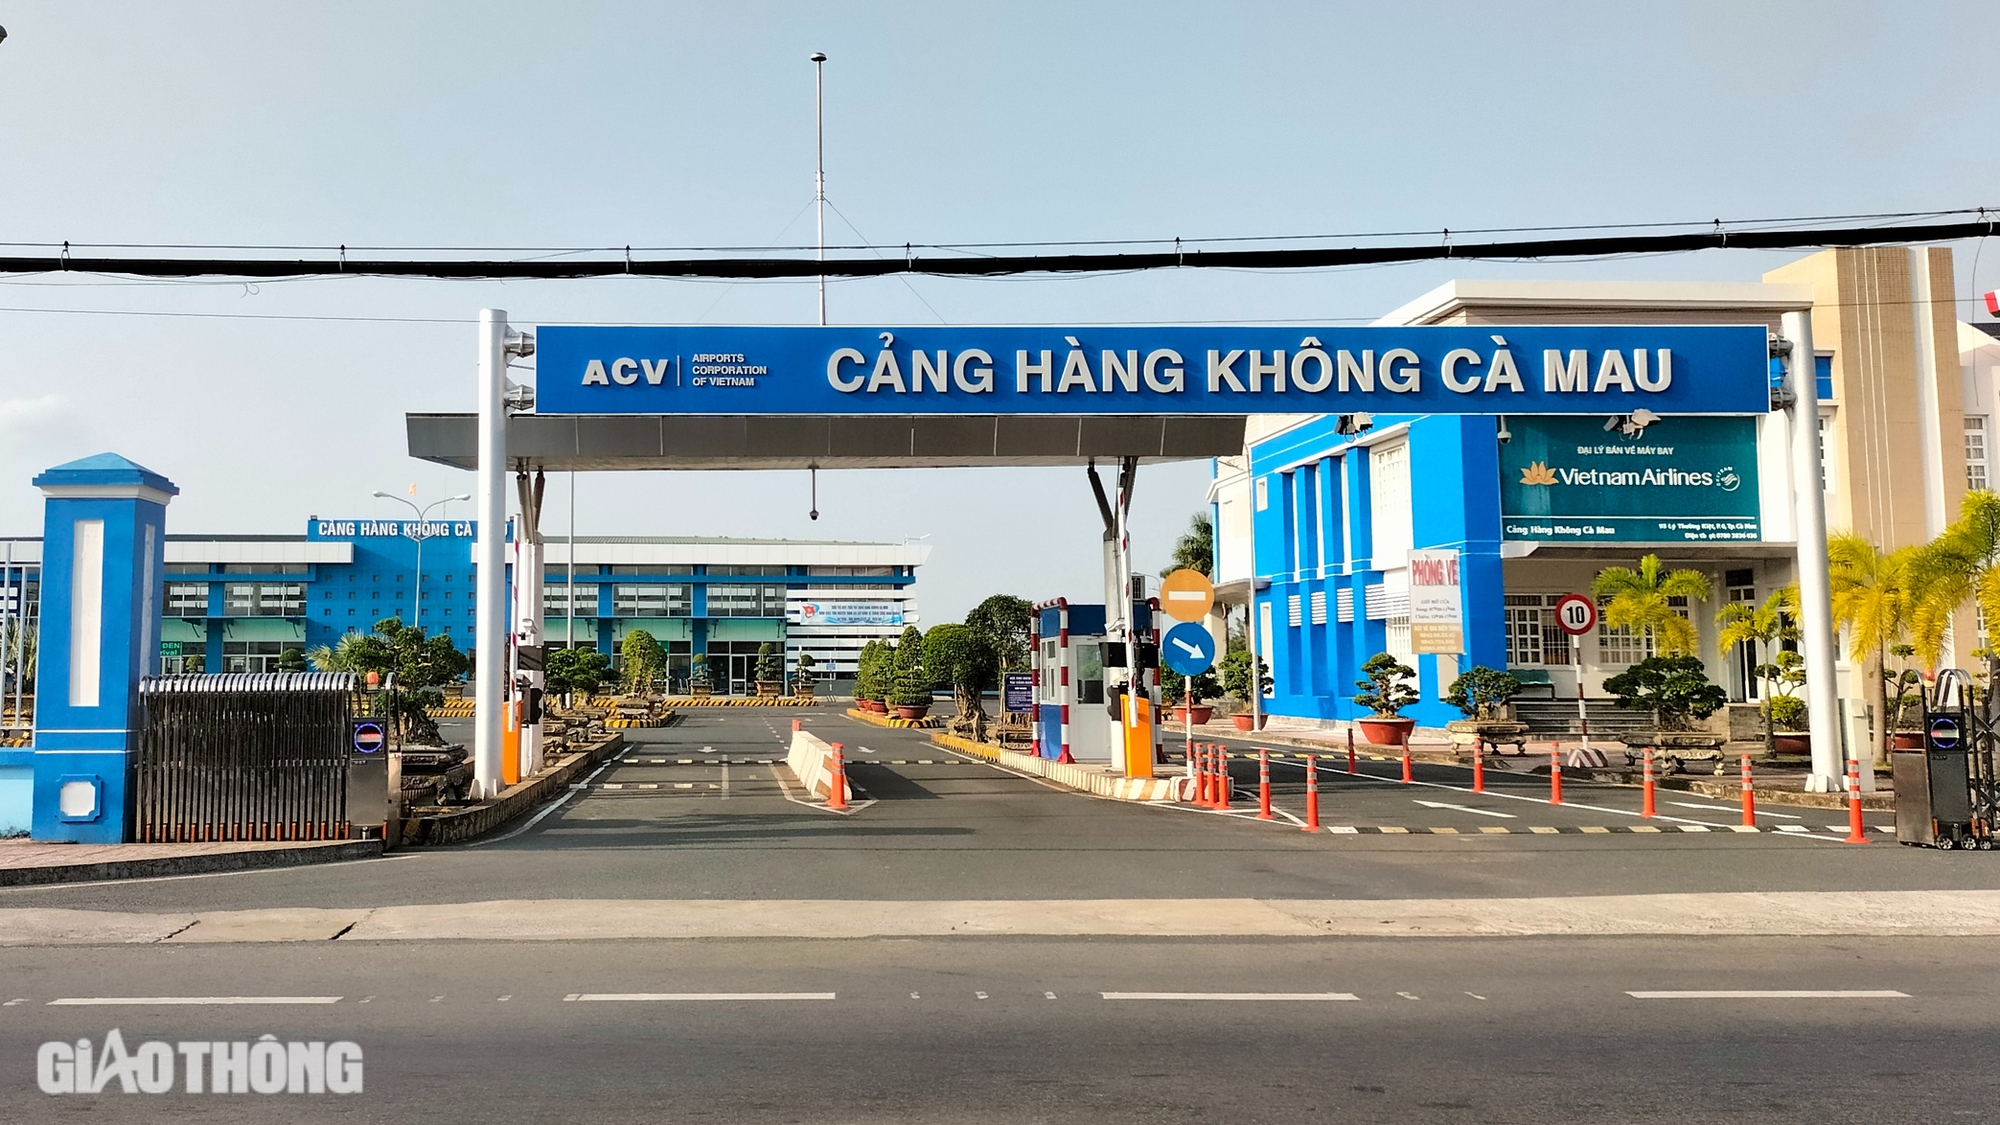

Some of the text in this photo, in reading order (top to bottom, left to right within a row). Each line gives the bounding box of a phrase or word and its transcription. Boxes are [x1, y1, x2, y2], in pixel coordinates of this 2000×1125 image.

[692, 353, 745, 363] AIRPORTS
[827, 332, 1672, 393] CẢNG HÀNG KHÔNG CÀ MAU
[581, 357, 669, 386] ACV
[692, 365, 767, 375] CORPORATION
[692, 377, 755, 386] OF VIETNAM
[1577, 446, 1592, 455] ĐẠI
[1594, 445, 1604, 454] LÝ
[1605, 445, 1623, 455] BÁN
[1637, 445, 1656, 455] MÁY
[1657, 446, 1674, 455] BAY
[1559, 468, 1713, 486] Vietnam Airlines
[318, 519, 473, 537] CẢNG HÀNG KHÔNG CÀ
[1506, 525, 1615, 536] Cảng Hàng Không Cà Mau
[1412, 554, 1443, 586] PHÒNG
[1566, 606, 1585, 624] 10
